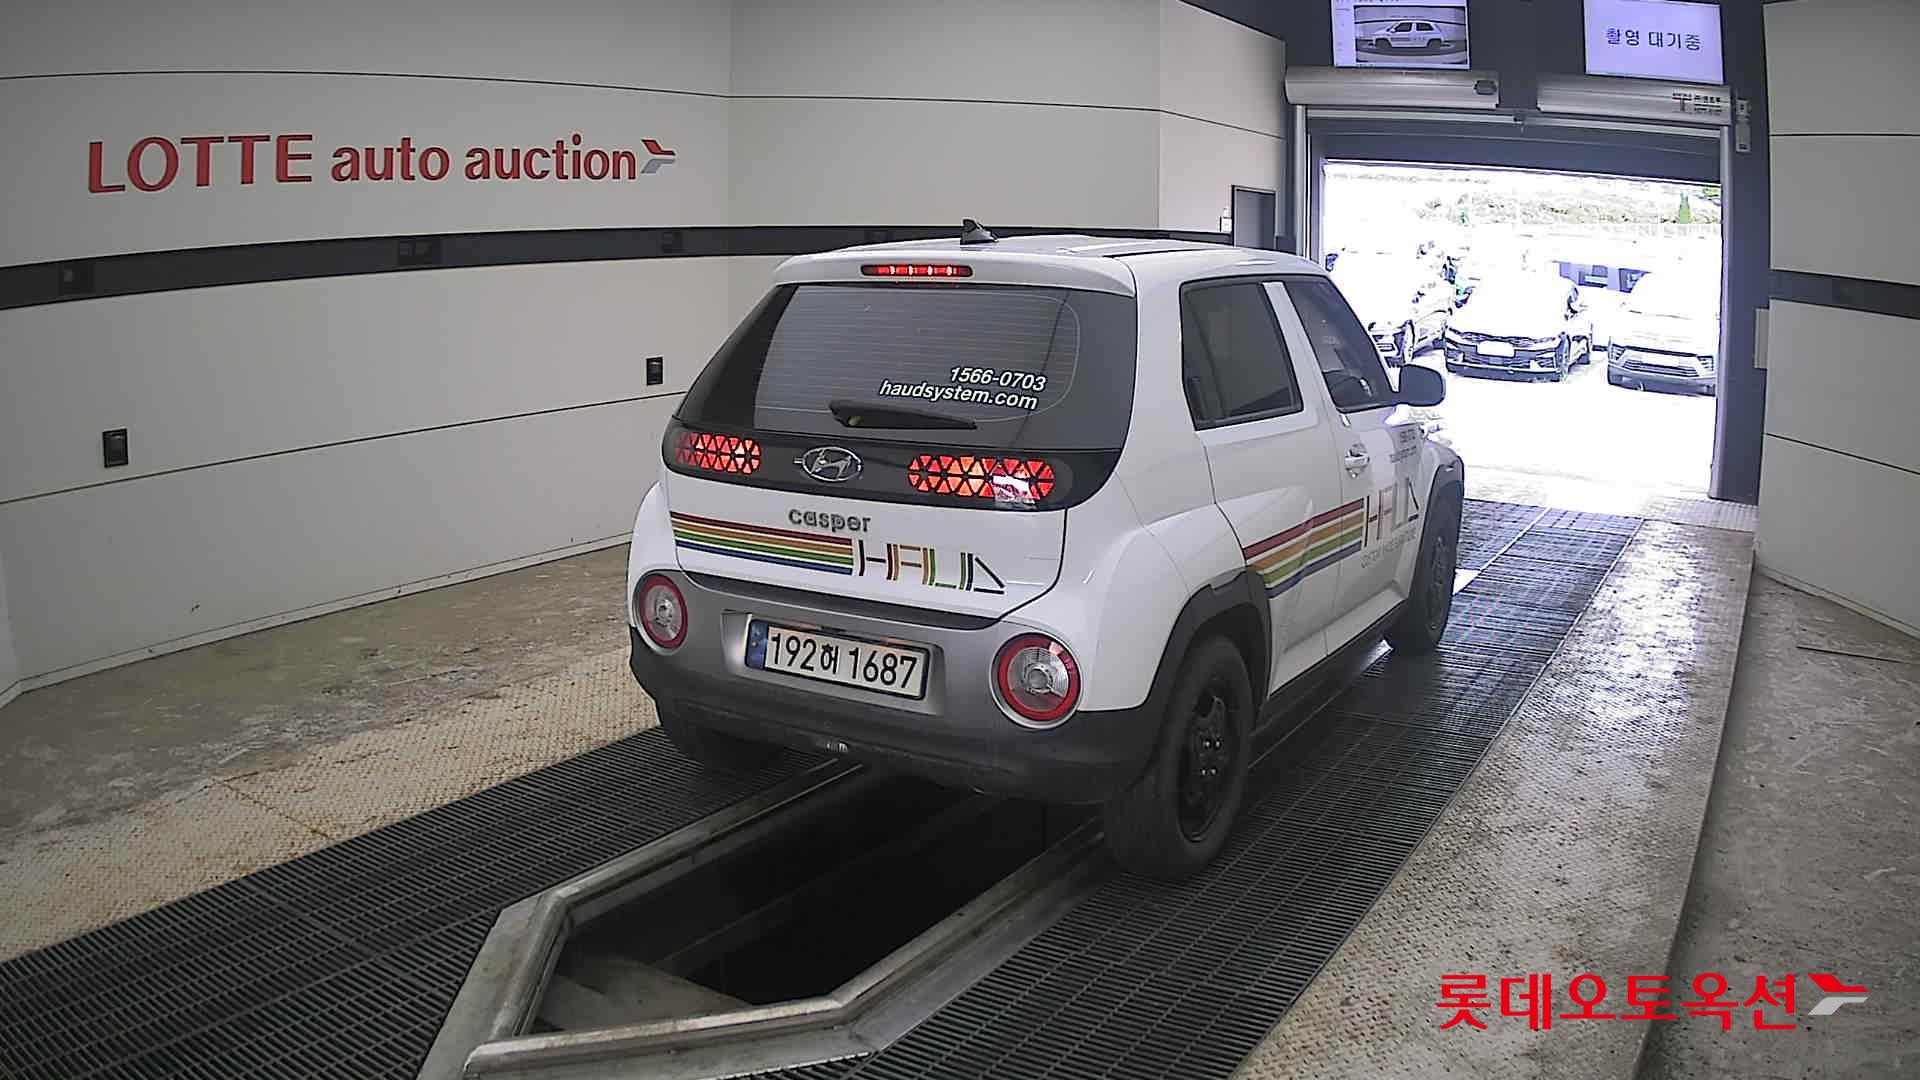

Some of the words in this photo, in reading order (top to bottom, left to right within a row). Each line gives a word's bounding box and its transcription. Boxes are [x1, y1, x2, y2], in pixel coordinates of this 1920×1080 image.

[1648, 31, 1701, 51] 대기중
[88, 135, 312, 193] LOTTE
[331, 137, 450, 182] auto
[464, 134, 637, 180] auction
[950, 366, 1047, 392] 1566-0703
[879, 379, 1038, 410] haudsystem.com
[788, 507, 872, 532] casper
[770, 632, 841, 675] 192허
[848, 646, 918, 689] 1687
